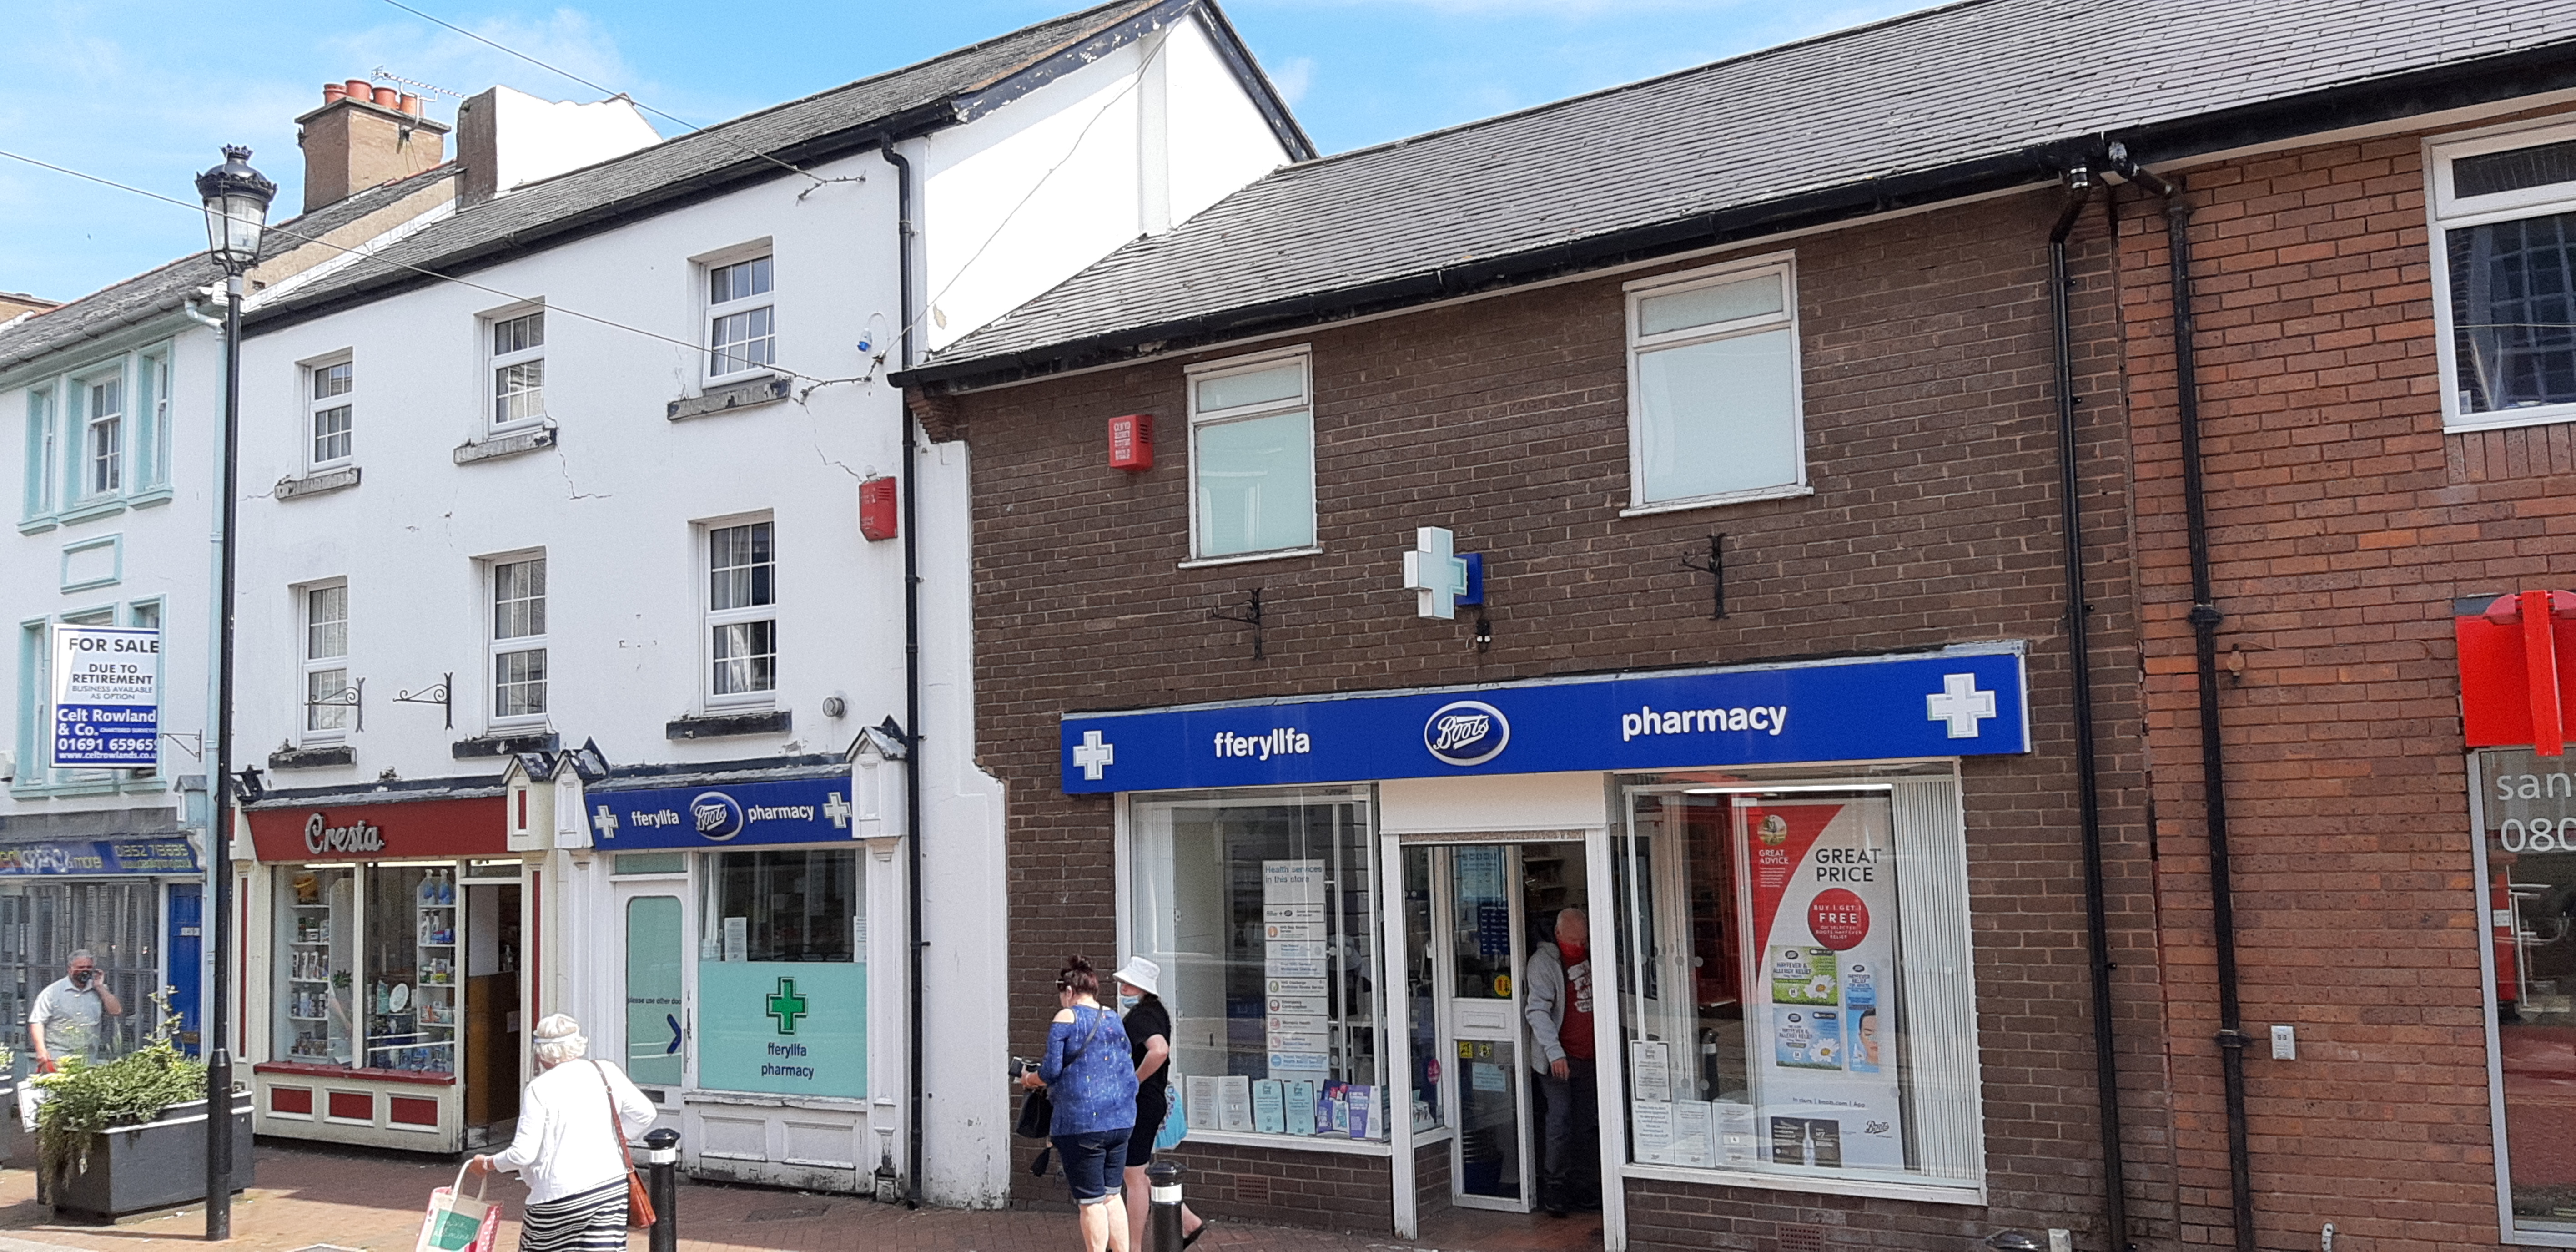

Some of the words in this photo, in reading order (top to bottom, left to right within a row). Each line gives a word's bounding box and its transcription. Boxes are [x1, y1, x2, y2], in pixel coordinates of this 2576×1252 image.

[70, 638, 107, 652] FOR
[114, 639, 159, 653] SALE
[89, 663, 116, 673] DUE
[120, 664, 138, 673] TO
[72, 674, 153, 684] RETIREMENT
[58, 708, 88, 722] Celt
[58, 723, 70, 736] &
[75, 723, 99, 736] Co.
[1214, 727, 1310, 761] fferyllfa
[1433, 714, 1489, 750] Boots
[1622, 705, 1787, 742] pharmacy
[58, 738, 103, 751] 01691
[2496, 772, 2576, 801] san
[631, 809, 679, 829] fferyllfa
[695, 803, 727, 831] Boots
[748, 804, 814, 823] pharmacy
[305, 813, 385, 854] Cresta
[1815, 848, 1882, 864] GREAT
[1816, 867, 1874, 882] PRICE
[1819, 913, 1858, 924] FREE
[768, 1042, 807, 1059] fferyllfa
[761, 1062, 814, 1080] pharmacy
[1864, 1120, 1890, 1134] Boots
